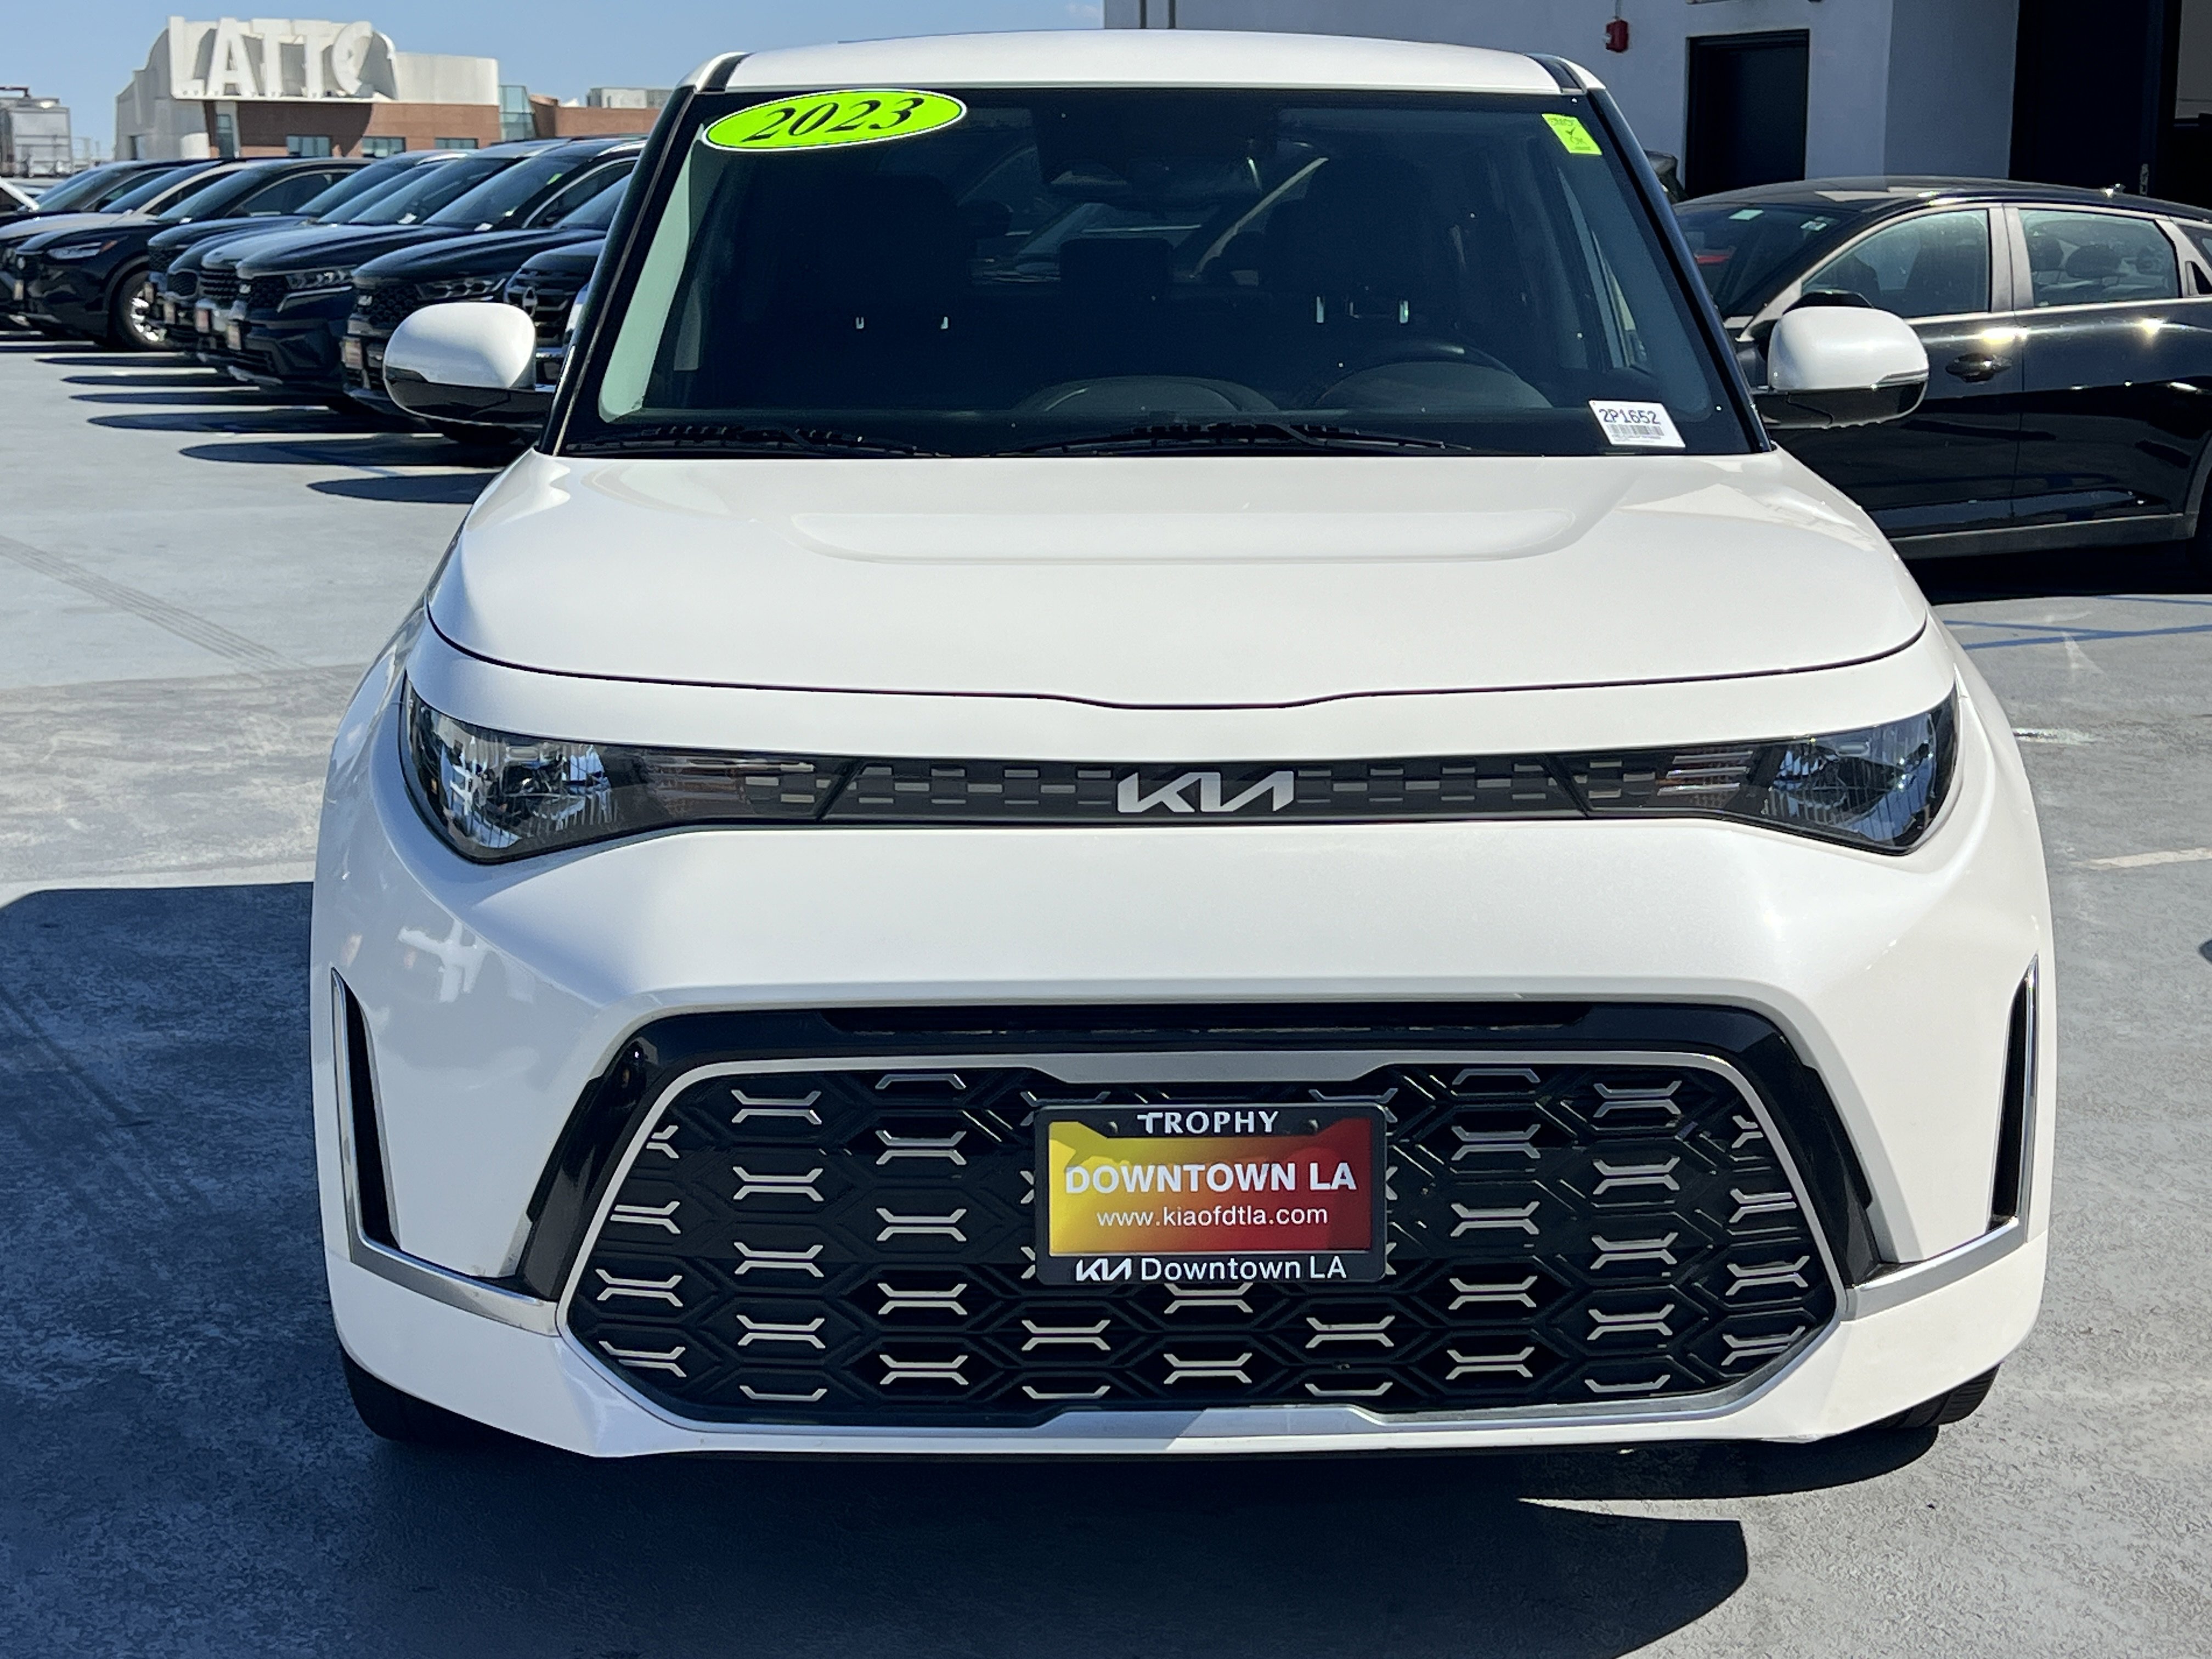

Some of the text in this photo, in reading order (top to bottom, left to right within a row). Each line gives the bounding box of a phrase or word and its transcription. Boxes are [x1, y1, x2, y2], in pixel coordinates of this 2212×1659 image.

[740, 97, 924, 143] 2023
[1599, 408, 1661, 424] 2P1652
[1137, 1111, 1279, 1135] TROPHY
[1065, 1162, 1357, 1194] DOWNTOWN LA
[1097, 1205, 1328, 1227] www.kiaofdtla.com
[1141, 1256, 1301, 1280] Downtown
[1309, 1256, 1347, 1279] LA
